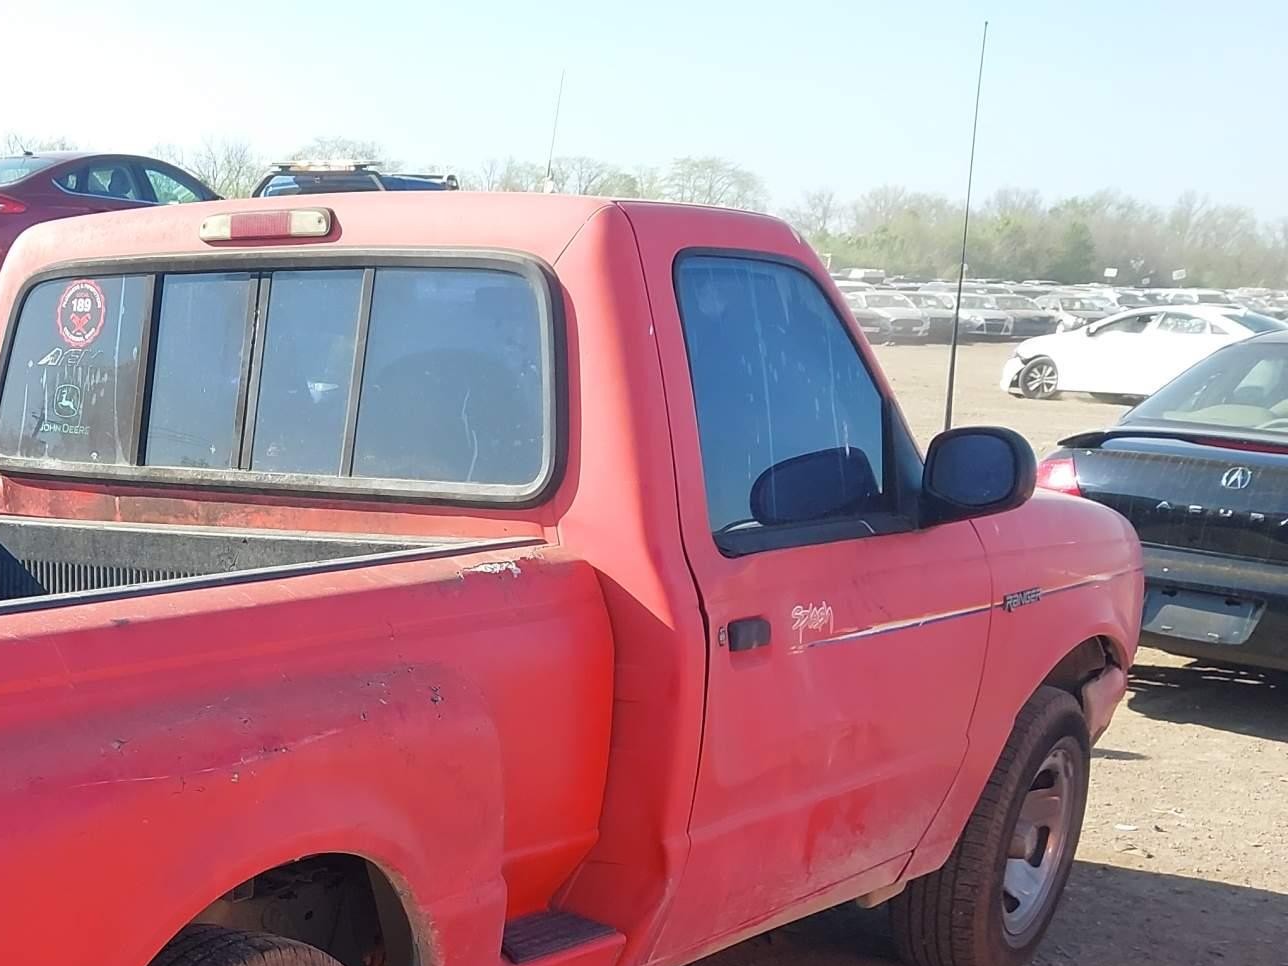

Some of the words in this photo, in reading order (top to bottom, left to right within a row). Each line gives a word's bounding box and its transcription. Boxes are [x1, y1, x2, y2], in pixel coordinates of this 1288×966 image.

[72, 298, 92, 312] 189
[39, 421, 61, 432] JOHN
[1005, 588, 1041, 612] RANGER
